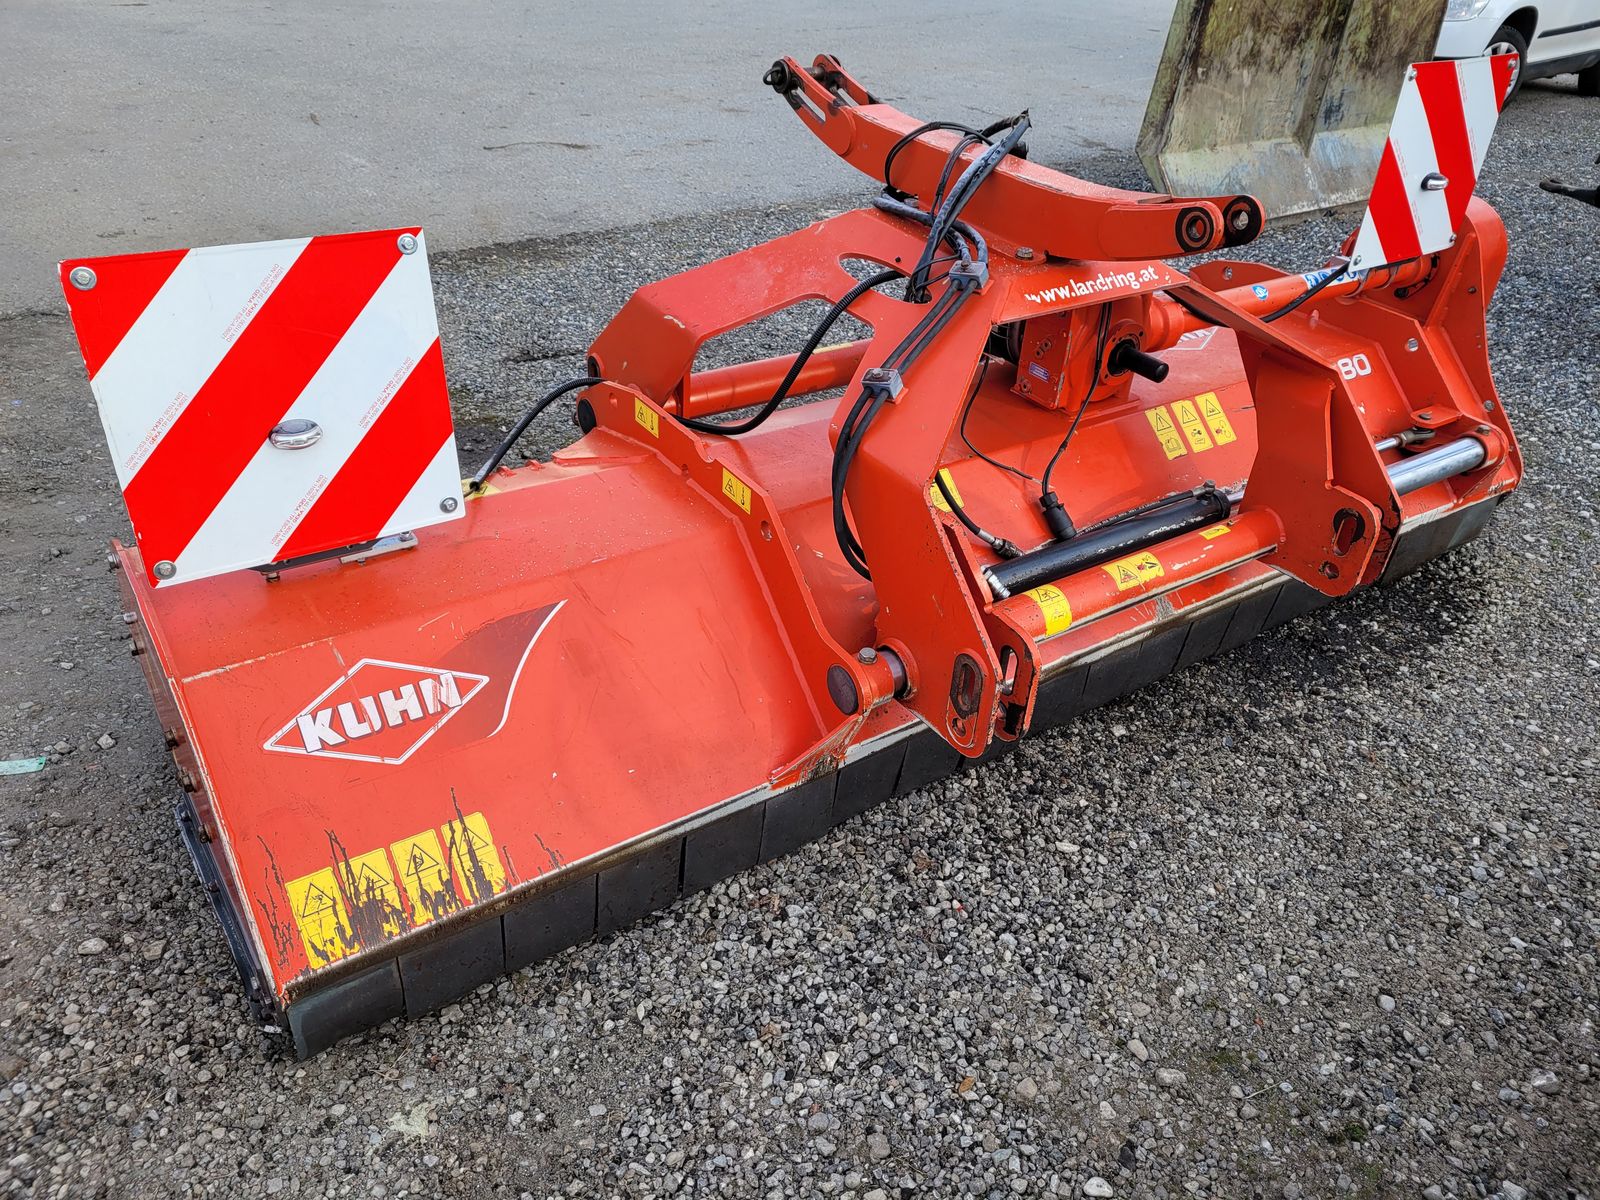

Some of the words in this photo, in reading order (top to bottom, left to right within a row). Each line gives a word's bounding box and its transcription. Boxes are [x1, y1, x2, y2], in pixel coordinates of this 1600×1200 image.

[247, 288, 261, 305] GEKA
[244, 301, 258, 318] GEKA
[382, 379, 394, 394] GEKA
[379, 391, 392, 406] GEKA
[151, 416, 165, 433] GEKA
[148, 430, 162, 446] GEKA
[294, 497, 307, 512] GEKA
[292, 509, 304, 524] GEKA
[297, 672, 464, 753] KUHN
